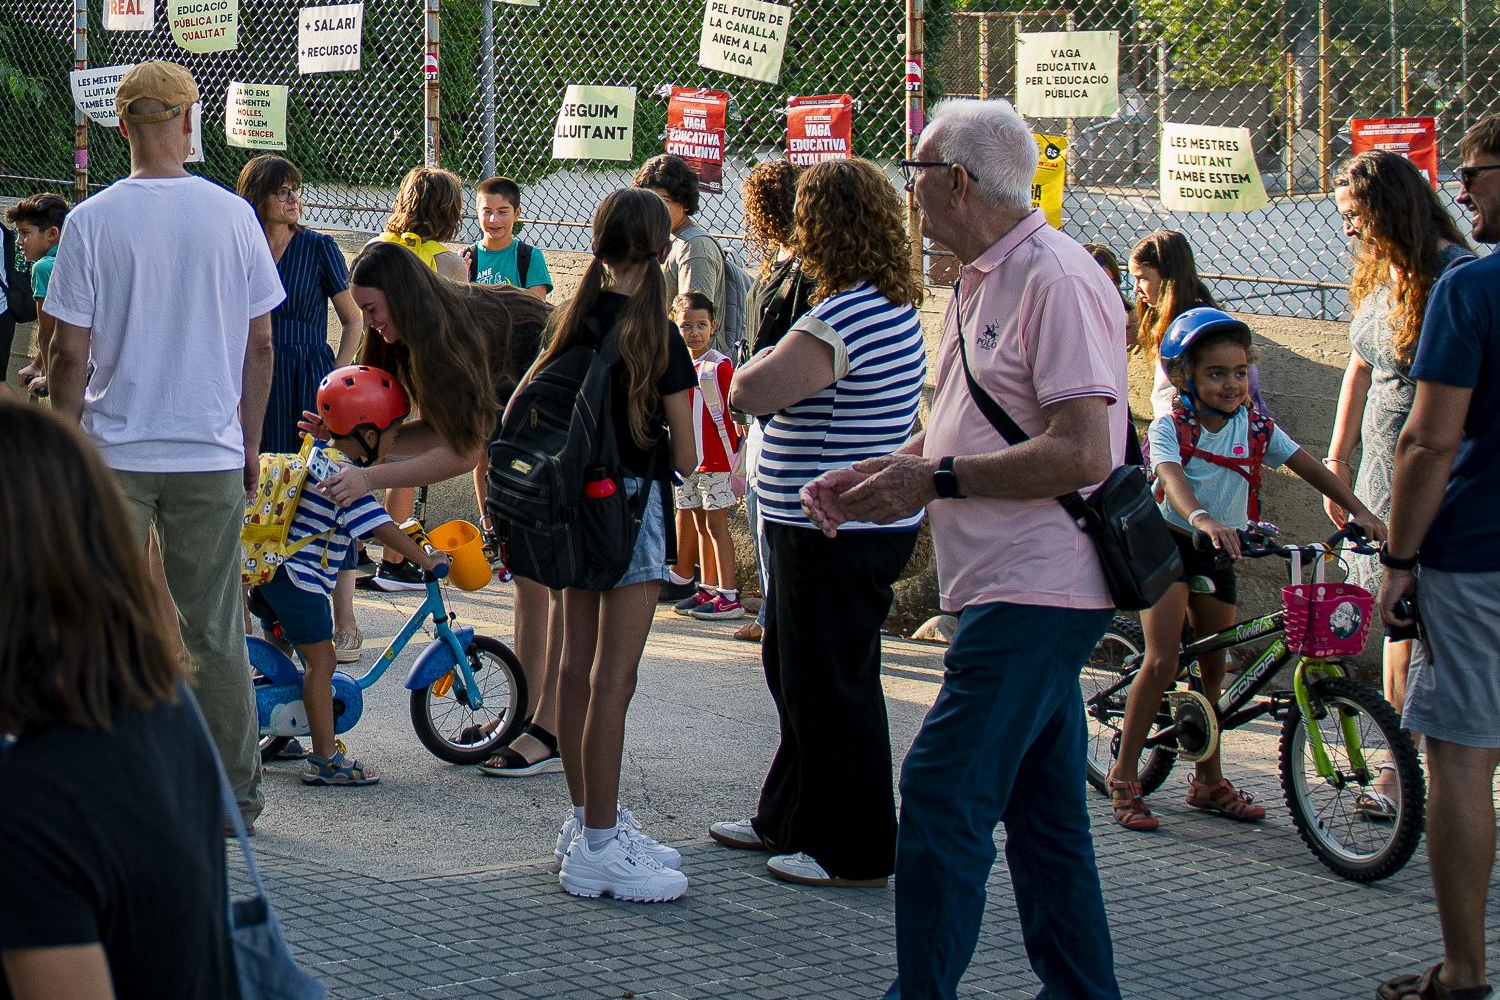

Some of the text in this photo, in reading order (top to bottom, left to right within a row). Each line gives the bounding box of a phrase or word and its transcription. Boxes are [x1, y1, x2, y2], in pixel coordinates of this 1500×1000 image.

[111, 0, 144, 15] REAL
[712, 2, 783, 25] PEL FUTUR DE
[174, 14, 232, 29] PÚBLICA I DE
[314, 17, 355, 32] SALARI
[182, 28, 226, 42] QUALITAT
[710, 17, 778, 42] LA CANALLA,
[712, 33, 766, 53] ANEM A LA
[308, 44, 357, 57] RECURSOS
[1051, 49, 1080, 58] VAGA
[724, 51, 752, 66] VAGA
[1037, 62, 1096, 72] EDUCATIVA
[78, 74, 125, 87] LES MESTRE
[1026, 73, 1108, 85] PER L'EDUCACIÓ
[84, 87, 117, 97] LLUITAN
[1045, 87, 1088, 98] PÚBLICA
[80, 98, 103, 109] TAMBÉ
[564, 104, 618, 118] SEGUIM
[683, 117, 706, 130] VAGA
[804, 124, 831, 136] VAGA
[558, 125, 627, 140] LLUITANT
[669, 128, 720, 146] EDUCATIVA
[790, 139, 846, 151] EDUCATIVA
[1170, 136, 1238, 151] LES MESTRES
[667, 143, 720, 160] CATALUNYA
[1178, 154, 1232, 167] LLUITANT
[1168, 168, 1251, 183] TAMBÉ ESTEM
[1180, 187, 1239, 199] EDUCANT
[477, 268, 492, 279] AME
[977, 338, 996, 348] POLO
[1229, 652, 1275, 703] CONOR
